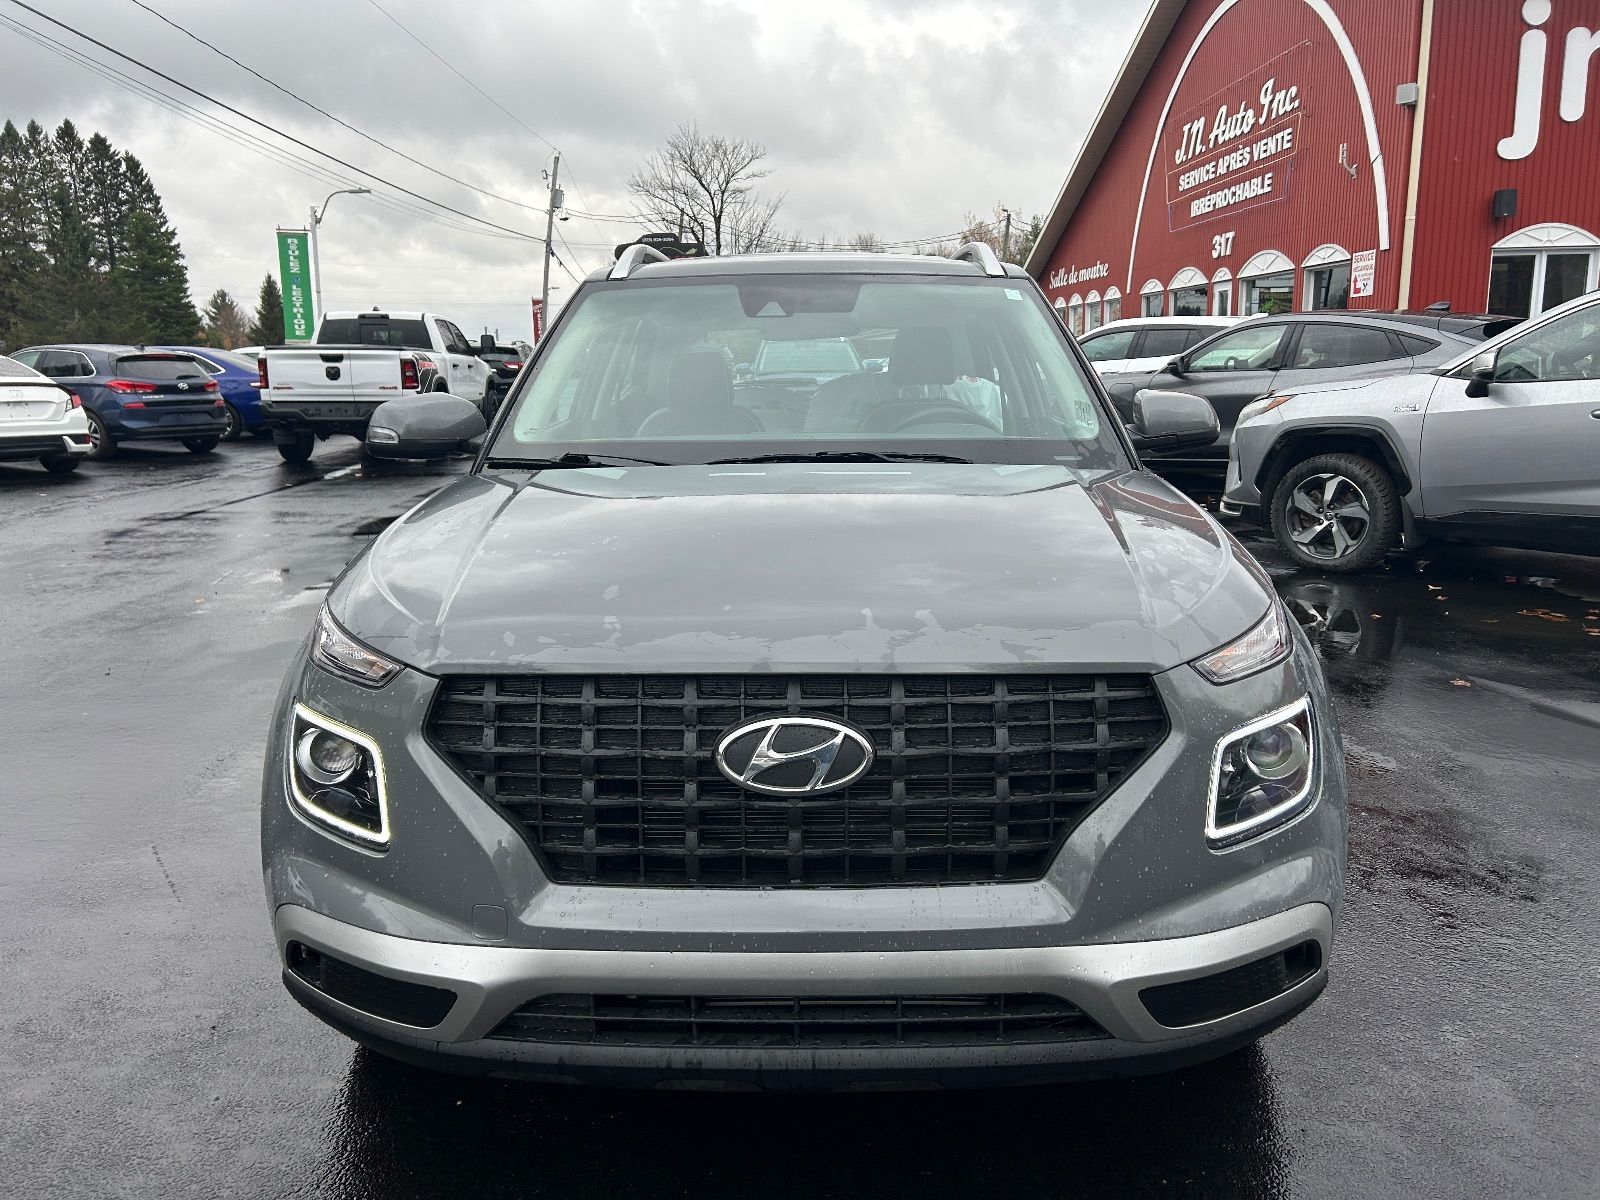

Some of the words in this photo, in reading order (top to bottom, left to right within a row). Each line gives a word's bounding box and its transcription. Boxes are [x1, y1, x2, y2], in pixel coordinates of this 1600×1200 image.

[1175, 116, 1206, 165] J.N.
[1209, 101, 1256, 149] Auto
[1259, 77, 1300, 125] Inc.
[1178, 160, 1216, 192] SERVICE
[1216, 145, 1250, 177] APRÈS
[1252, 128, 1293, 162] VENTE
[1190, 172, 1273, 218] IRRÉPROCHABLE
[1211, 231, 1235, 259] 317
[1353, 251, 1375, 263] SERVICE
[1049, 267, 1068, 289] Salle
[1068, 264, 1078, 285] de
[1078, 260, 1109, 282] montre
